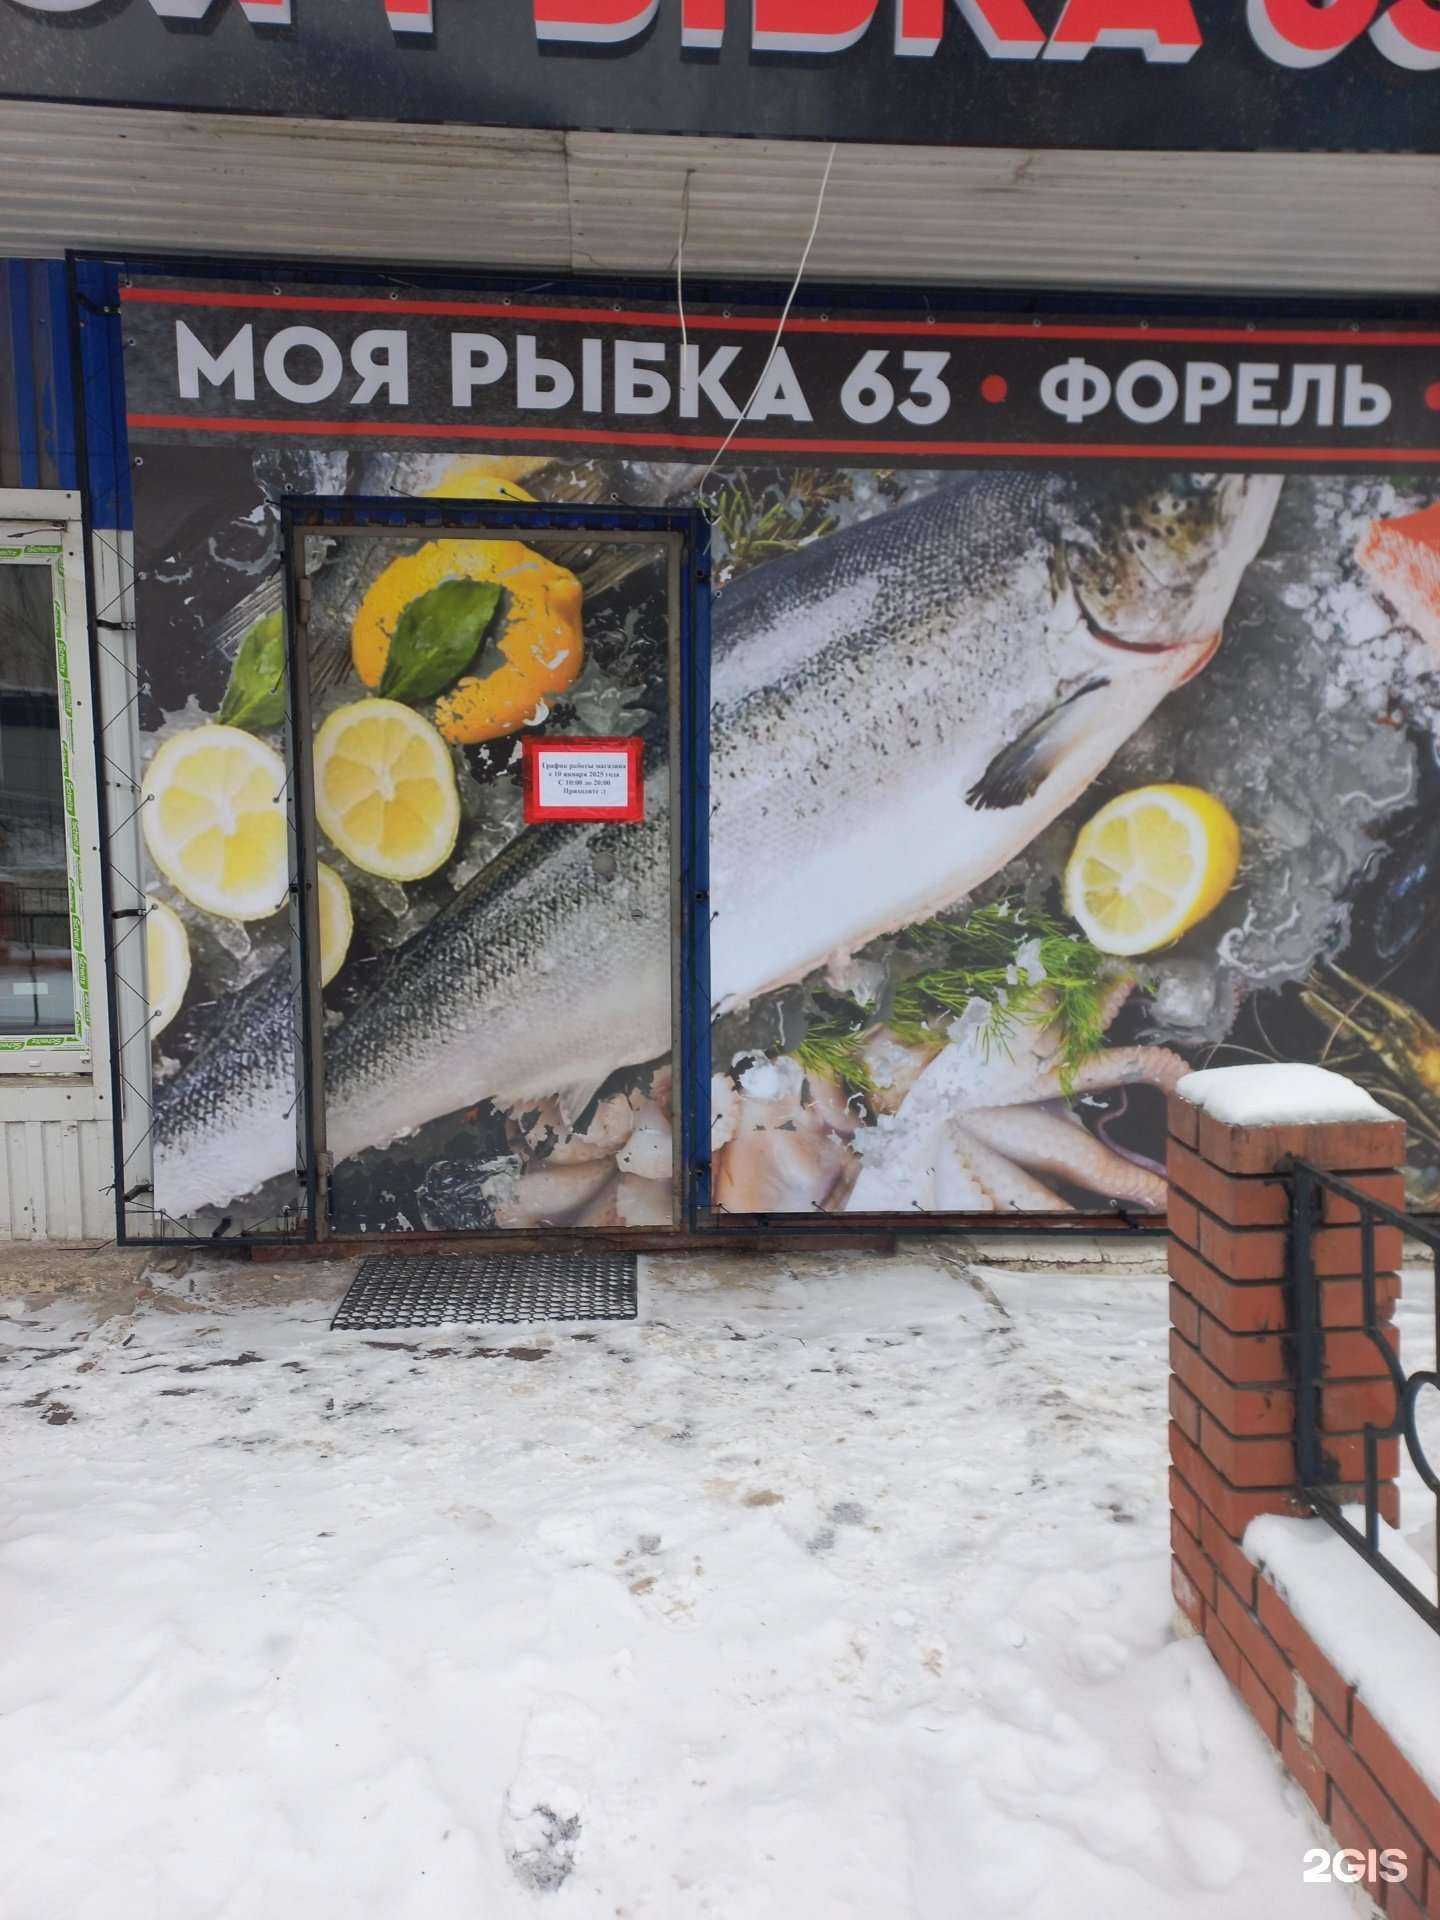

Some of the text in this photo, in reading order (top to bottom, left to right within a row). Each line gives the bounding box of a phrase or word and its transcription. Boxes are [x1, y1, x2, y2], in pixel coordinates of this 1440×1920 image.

[175, 320, 1393, 428] МОЯ РЫБКА 63 ФОРЕЛЬ
[542, 762, 568, 770] График
[569, 762, 594, 770] работы
